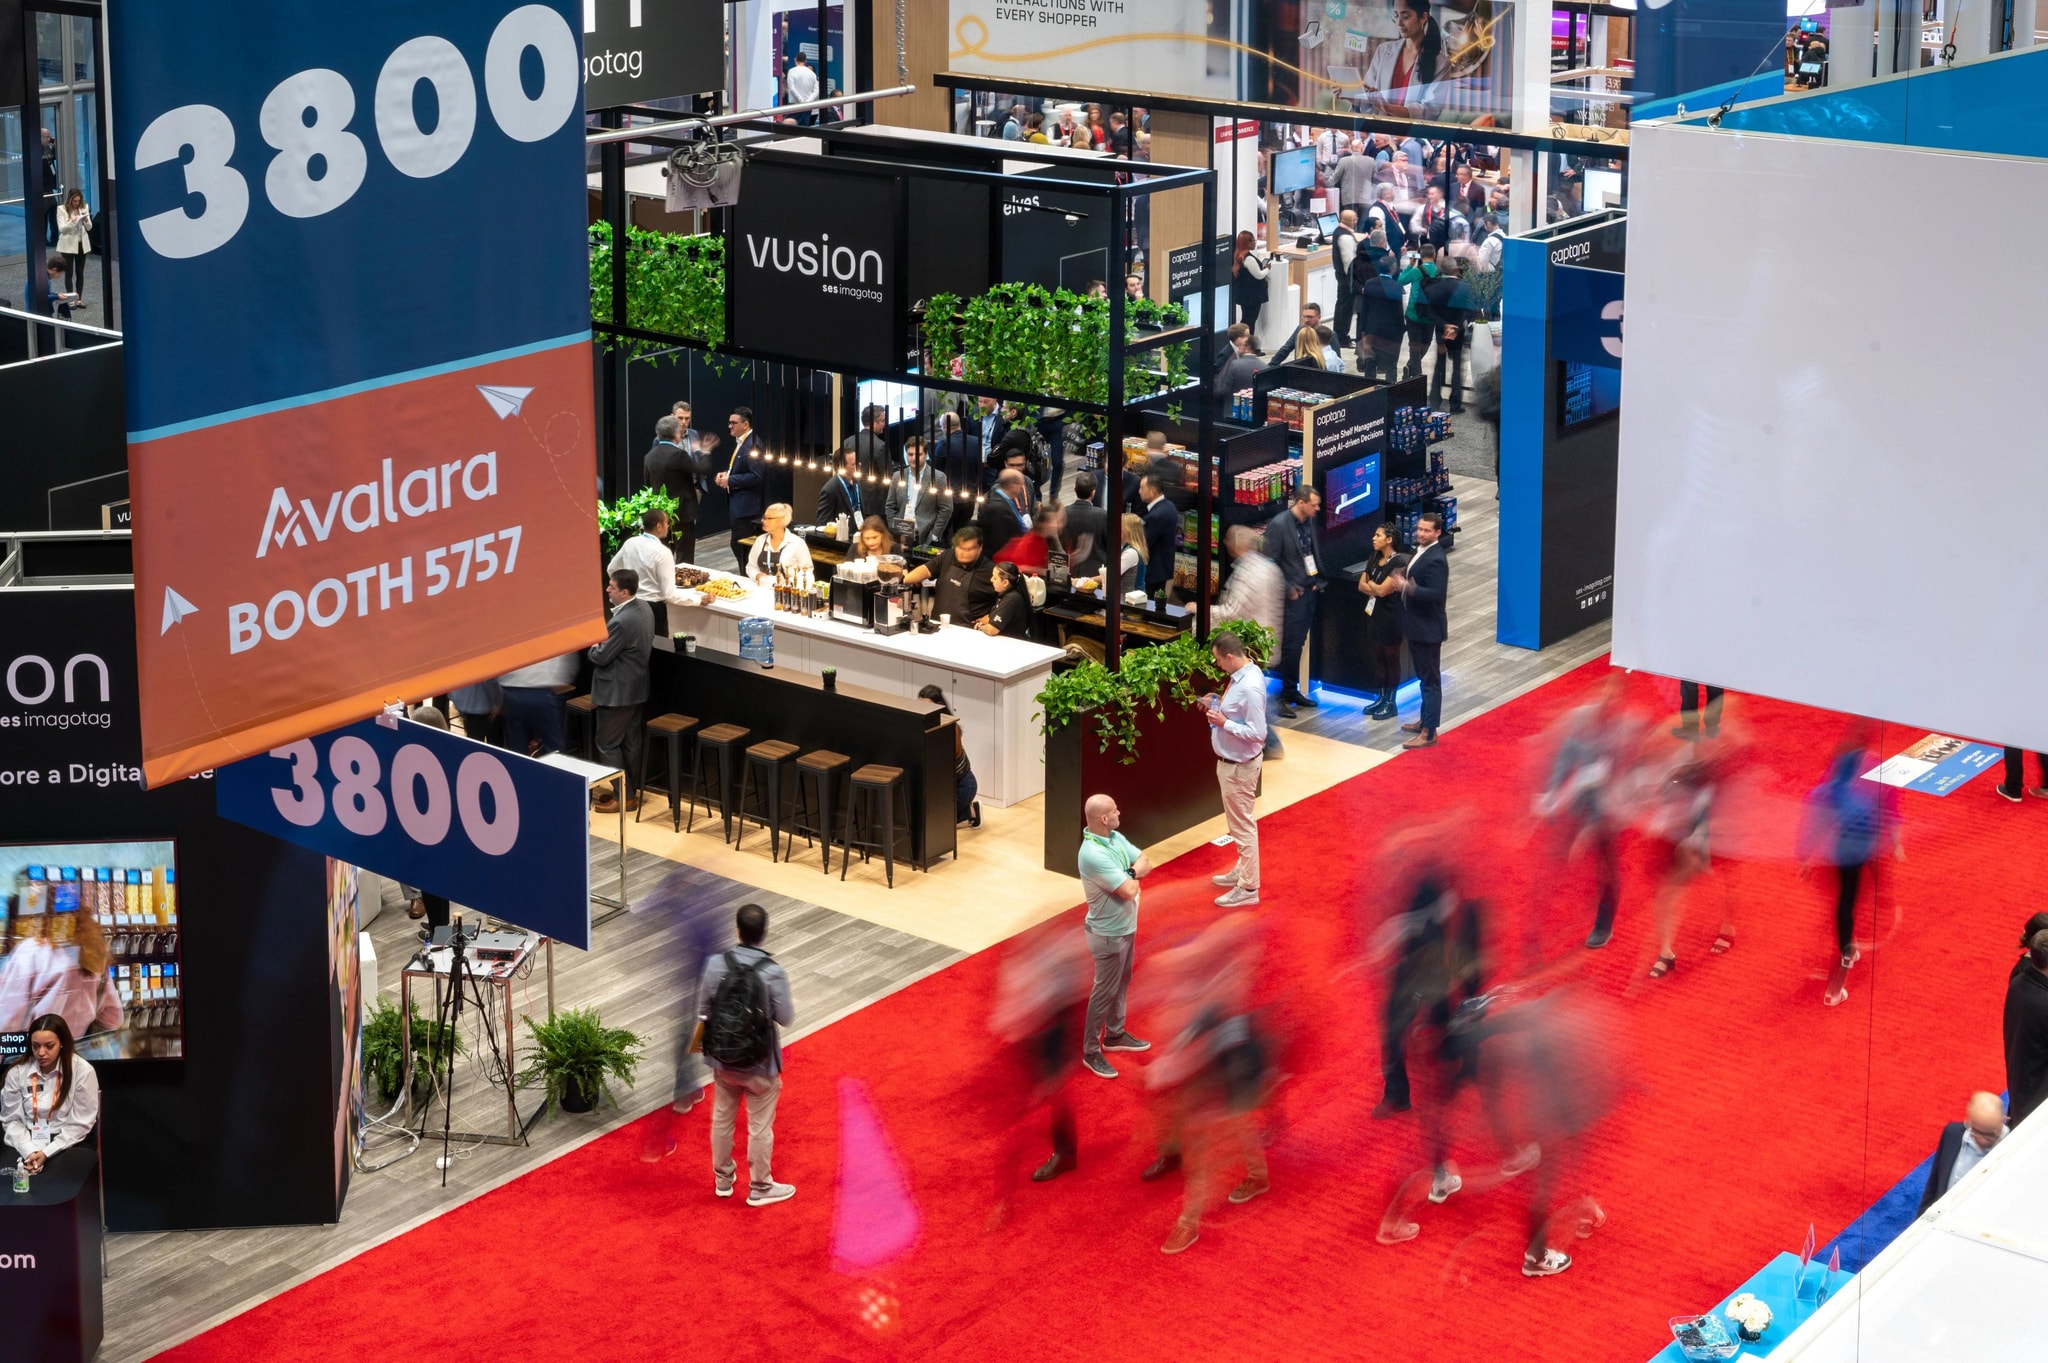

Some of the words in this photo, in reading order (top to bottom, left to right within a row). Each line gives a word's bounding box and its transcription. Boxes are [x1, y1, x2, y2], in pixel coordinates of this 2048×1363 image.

[997, 0, 1086, 11] ACTIONS
[1090, 0, 1124, 13] WITH
[996, 8, 1034, 21] EVERY
[1038, 11, 1097, 27] SHOPPER
[135, 4, 579, 259] 3800
[1551, 241, 1590, 264] captana
[822, 284, 839, 294] ses
[839, 284, 883, 303] imagotag
[1316, 408, 1346, 427] captana
[1316, 433, 1340, 448] Optimize
[1340, 426, 1354, 439] Shelf
[1354, 416, 1385, 435] Management
[1316, 445, 1337, 460] through
[1337, 438, 1361, 451] AI-driven
[1361, 429, 1384, 444] Decisions
[256, 451, 498, 559] Avalara
[228, 556, 413, 655] BOOTH
[425, 525, 523, 597] 5757
[24, 711, 111, 730] imagotag
[47, 770, 61, 785] a
[268, 735, 520, 856] 3800
[1, 1033, 25, 1044] shop
